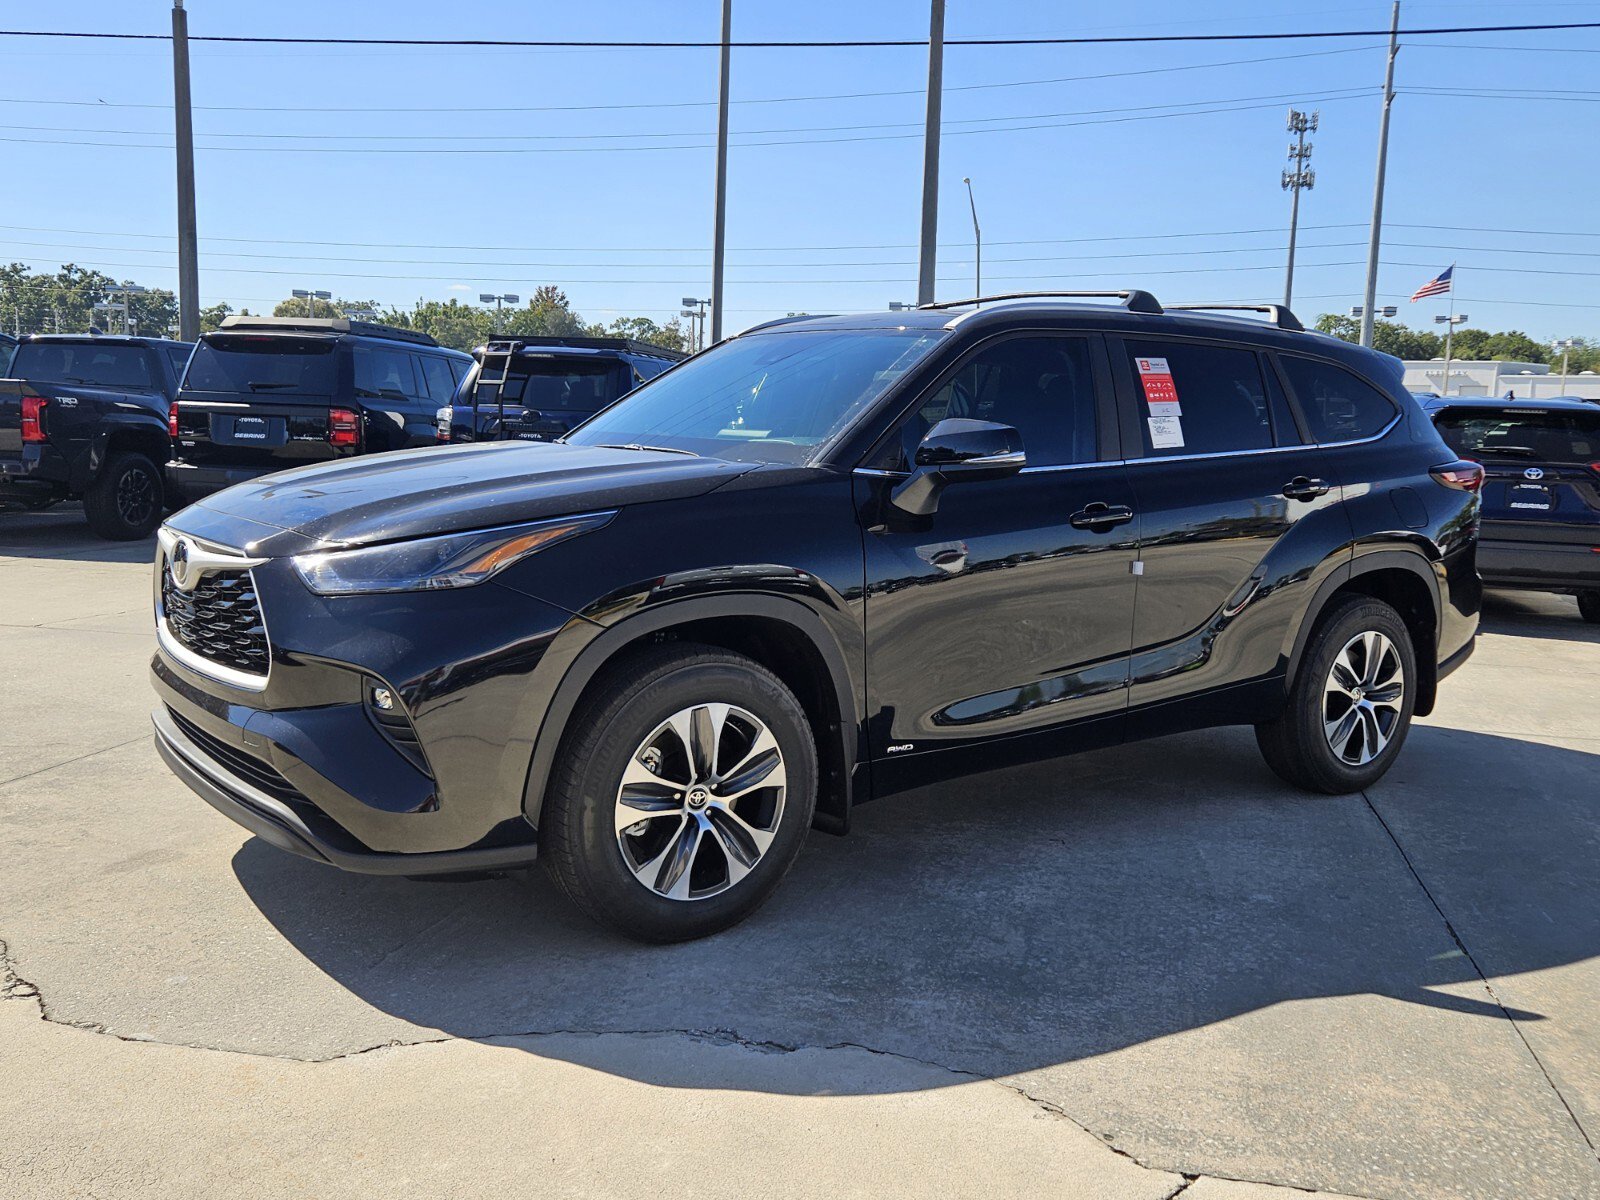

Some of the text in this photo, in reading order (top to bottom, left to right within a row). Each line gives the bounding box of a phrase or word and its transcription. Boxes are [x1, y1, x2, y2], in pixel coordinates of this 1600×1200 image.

[55, 396, 78, 404] TRD
[1361, 605, 1407, 637] BRIDGESTO
[886, 743, 914, 753] AWD
